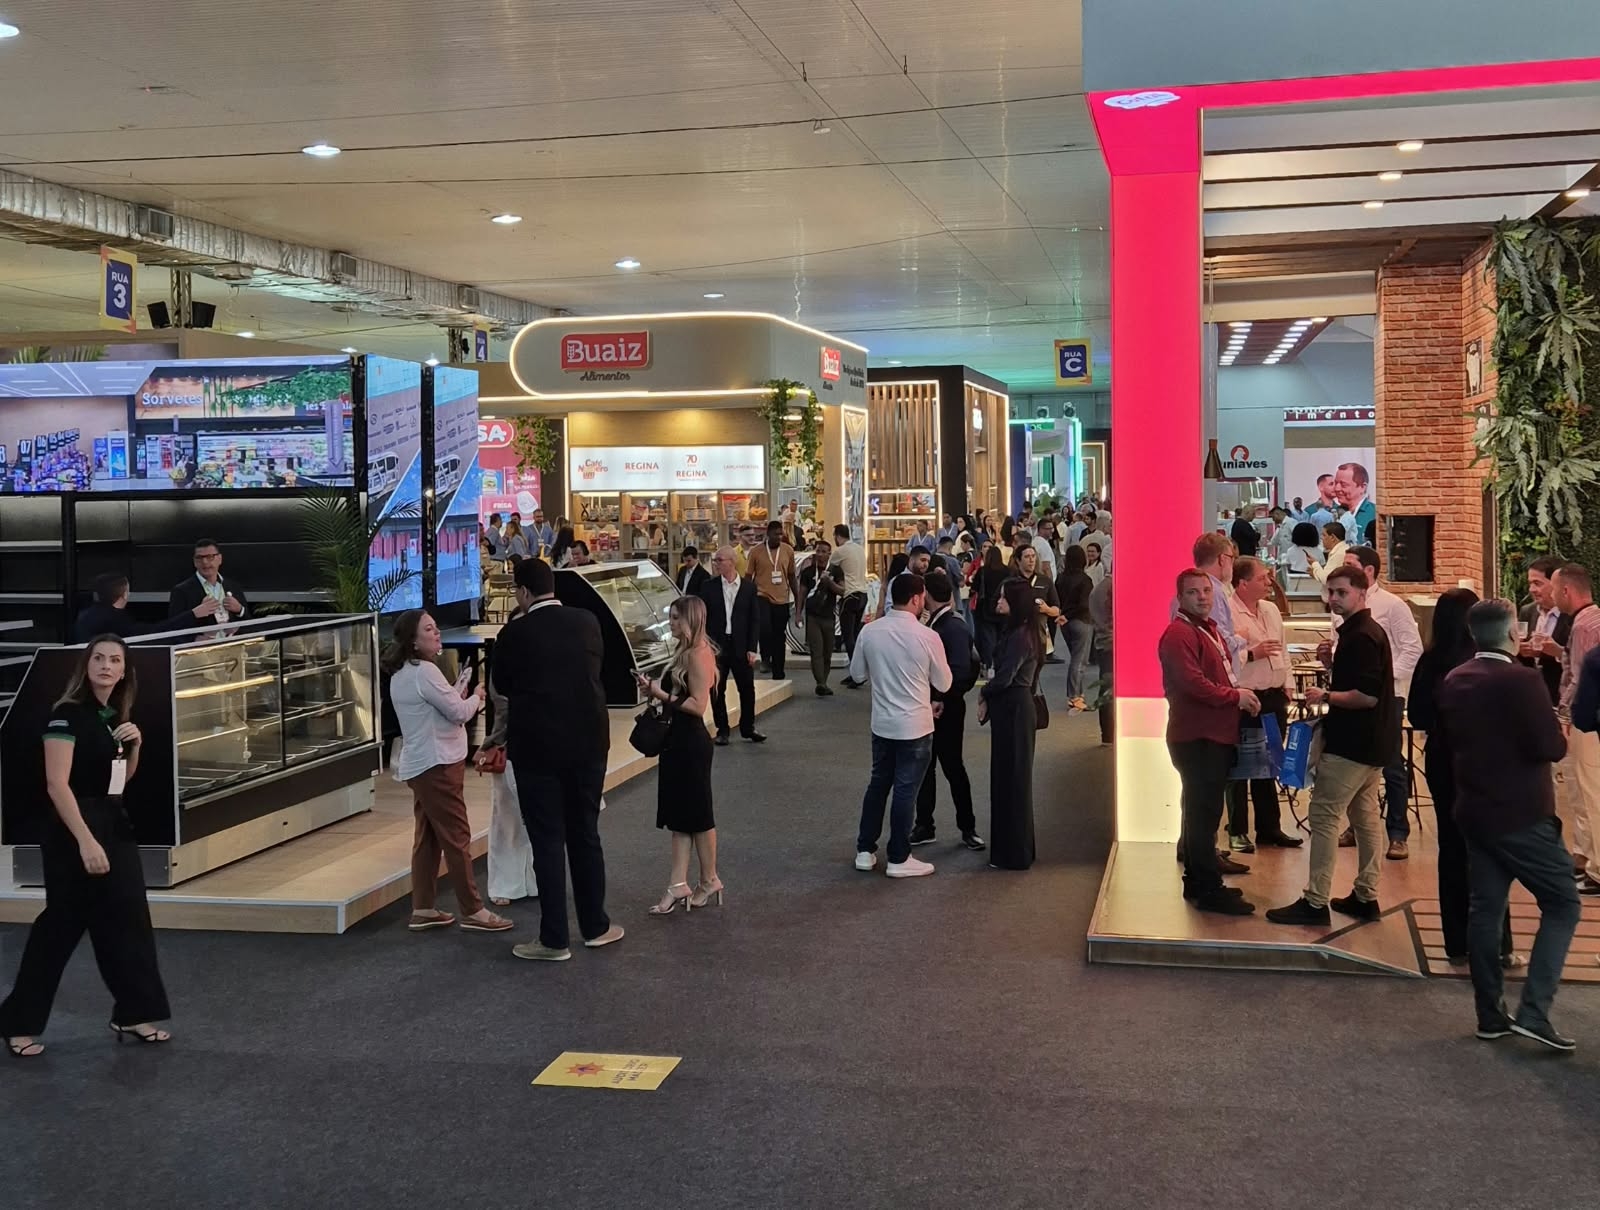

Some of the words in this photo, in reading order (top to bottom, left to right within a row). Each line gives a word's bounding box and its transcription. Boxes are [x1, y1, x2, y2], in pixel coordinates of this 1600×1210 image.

[112, 271, 129, 284] RUA
[113, 283, 127, 308] 3
[478, 345, 485, 360] 4
[566, 337, 642, 363] Buaiz
[1065, 357, 1082, 373] C
[580, 371, 631, 382] Alimentos
[142, 393, 203, 406] Sorvetes
[20, 440, 32, 455] 07
[625, 462, 660, 470] REGINA
[686, 455, 698, 464] 70
[676, 470, 707, 478] REGINA
